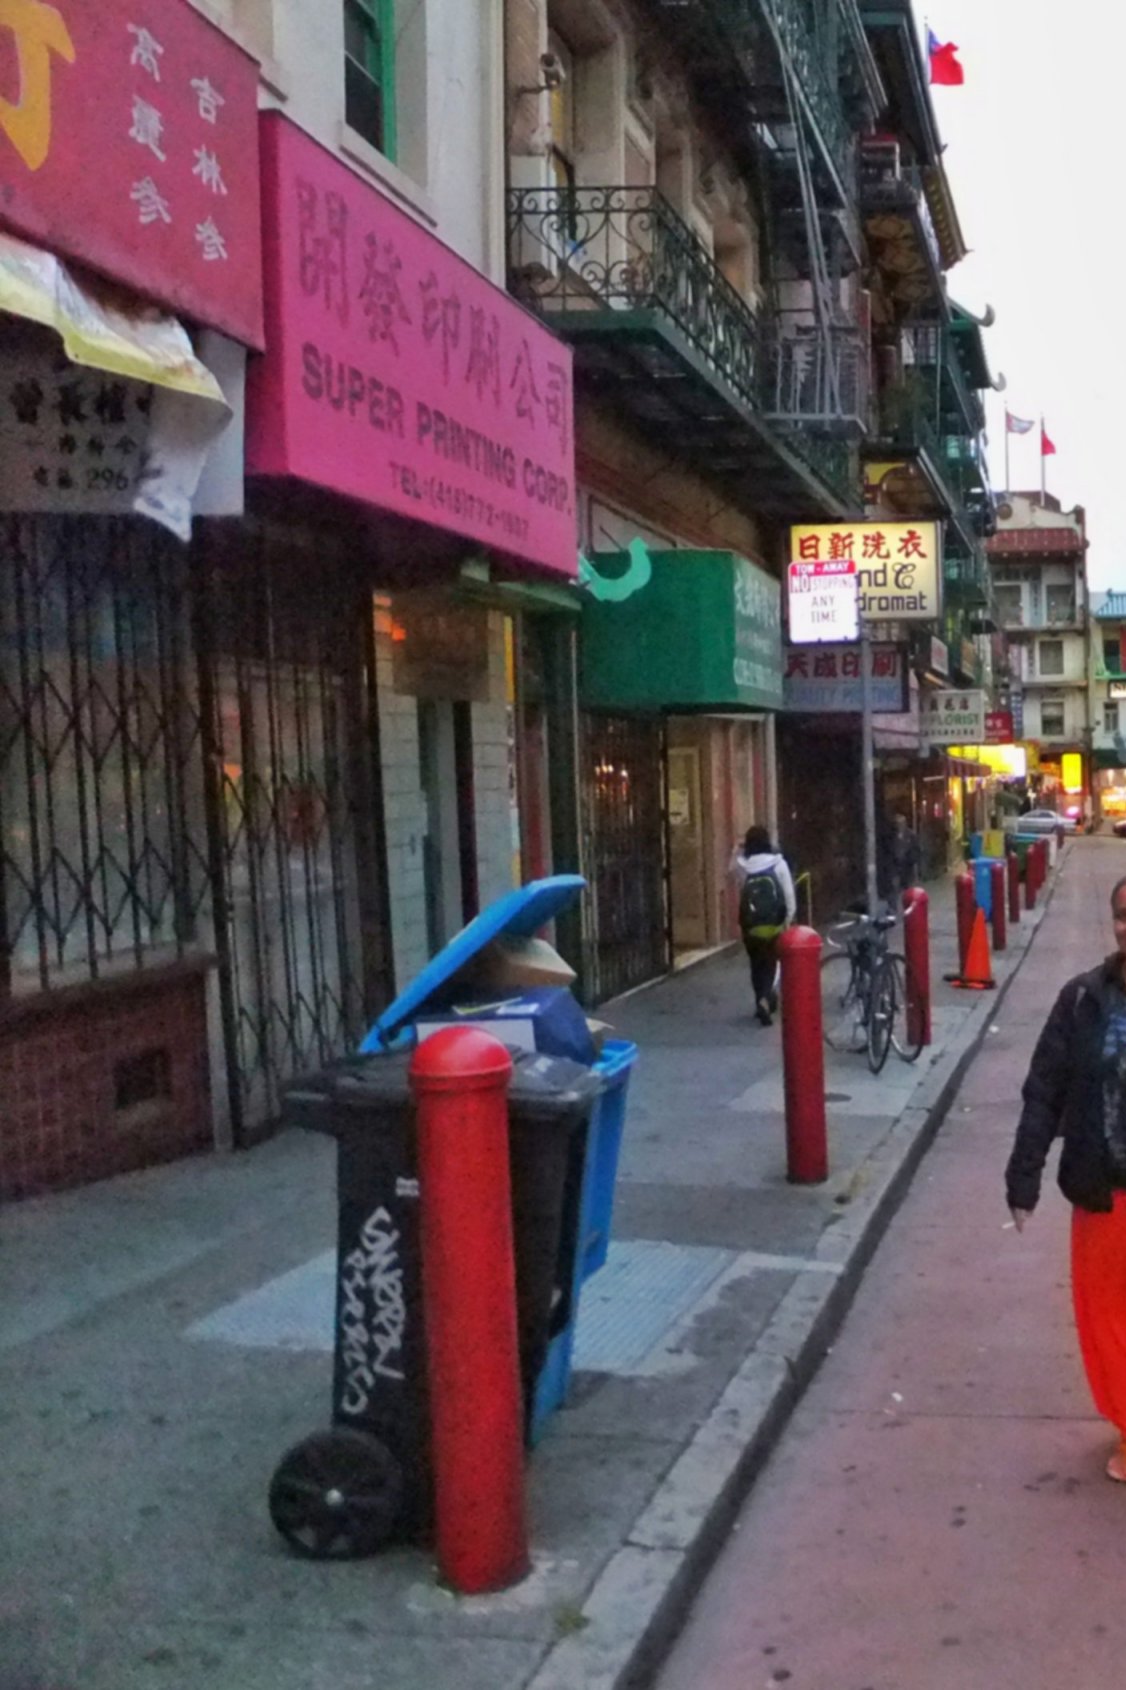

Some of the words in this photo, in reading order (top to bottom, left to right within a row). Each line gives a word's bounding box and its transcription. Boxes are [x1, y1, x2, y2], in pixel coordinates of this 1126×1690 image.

[302, 340, 405, 440] SUPER
[416, 400, 516, 490] PRINTING
[522, 457, 572, 516] CORP.
[798, 529, 928, 560] 日新洗衣
[790, 574, 812, 593] NO
[811, 595, 836, 607] ANY
[855, 590, 928, 611] dromat
[811, 609, 838, 623] TIME
